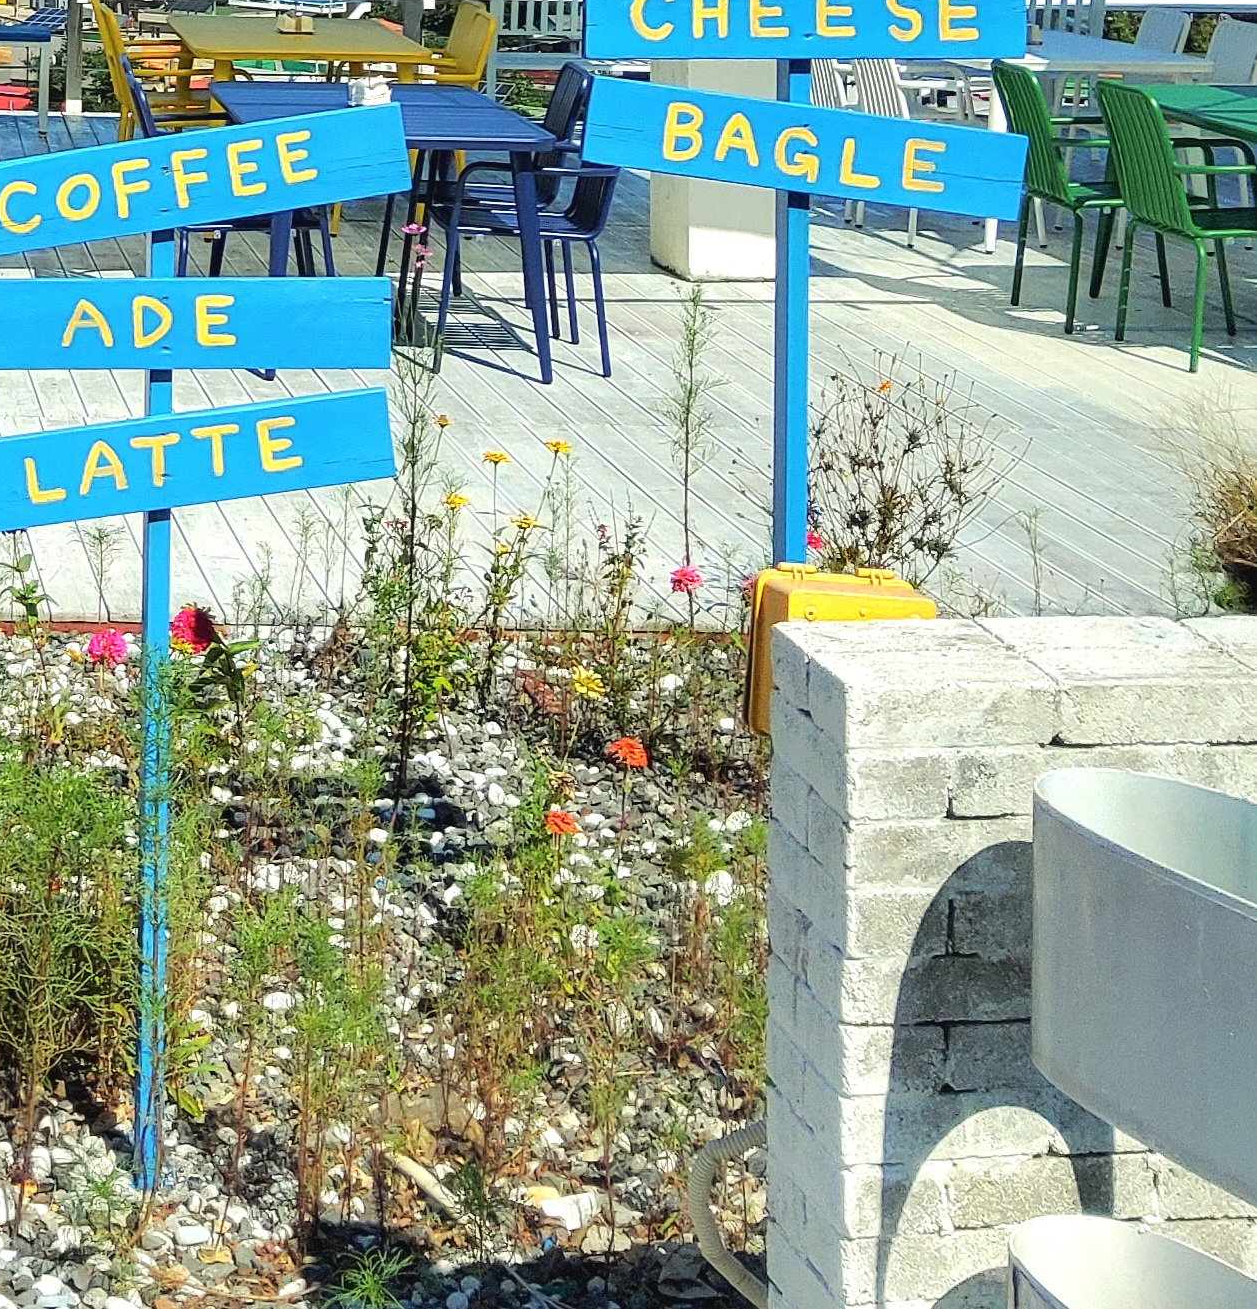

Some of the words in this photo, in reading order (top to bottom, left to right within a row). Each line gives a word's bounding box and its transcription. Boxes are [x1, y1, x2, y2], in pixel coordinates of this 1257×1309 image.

[662, 102, 946, 192] BAGLE
[62, 295, 237, 348] ADE
[24, 417, 303, 504] LATTE
